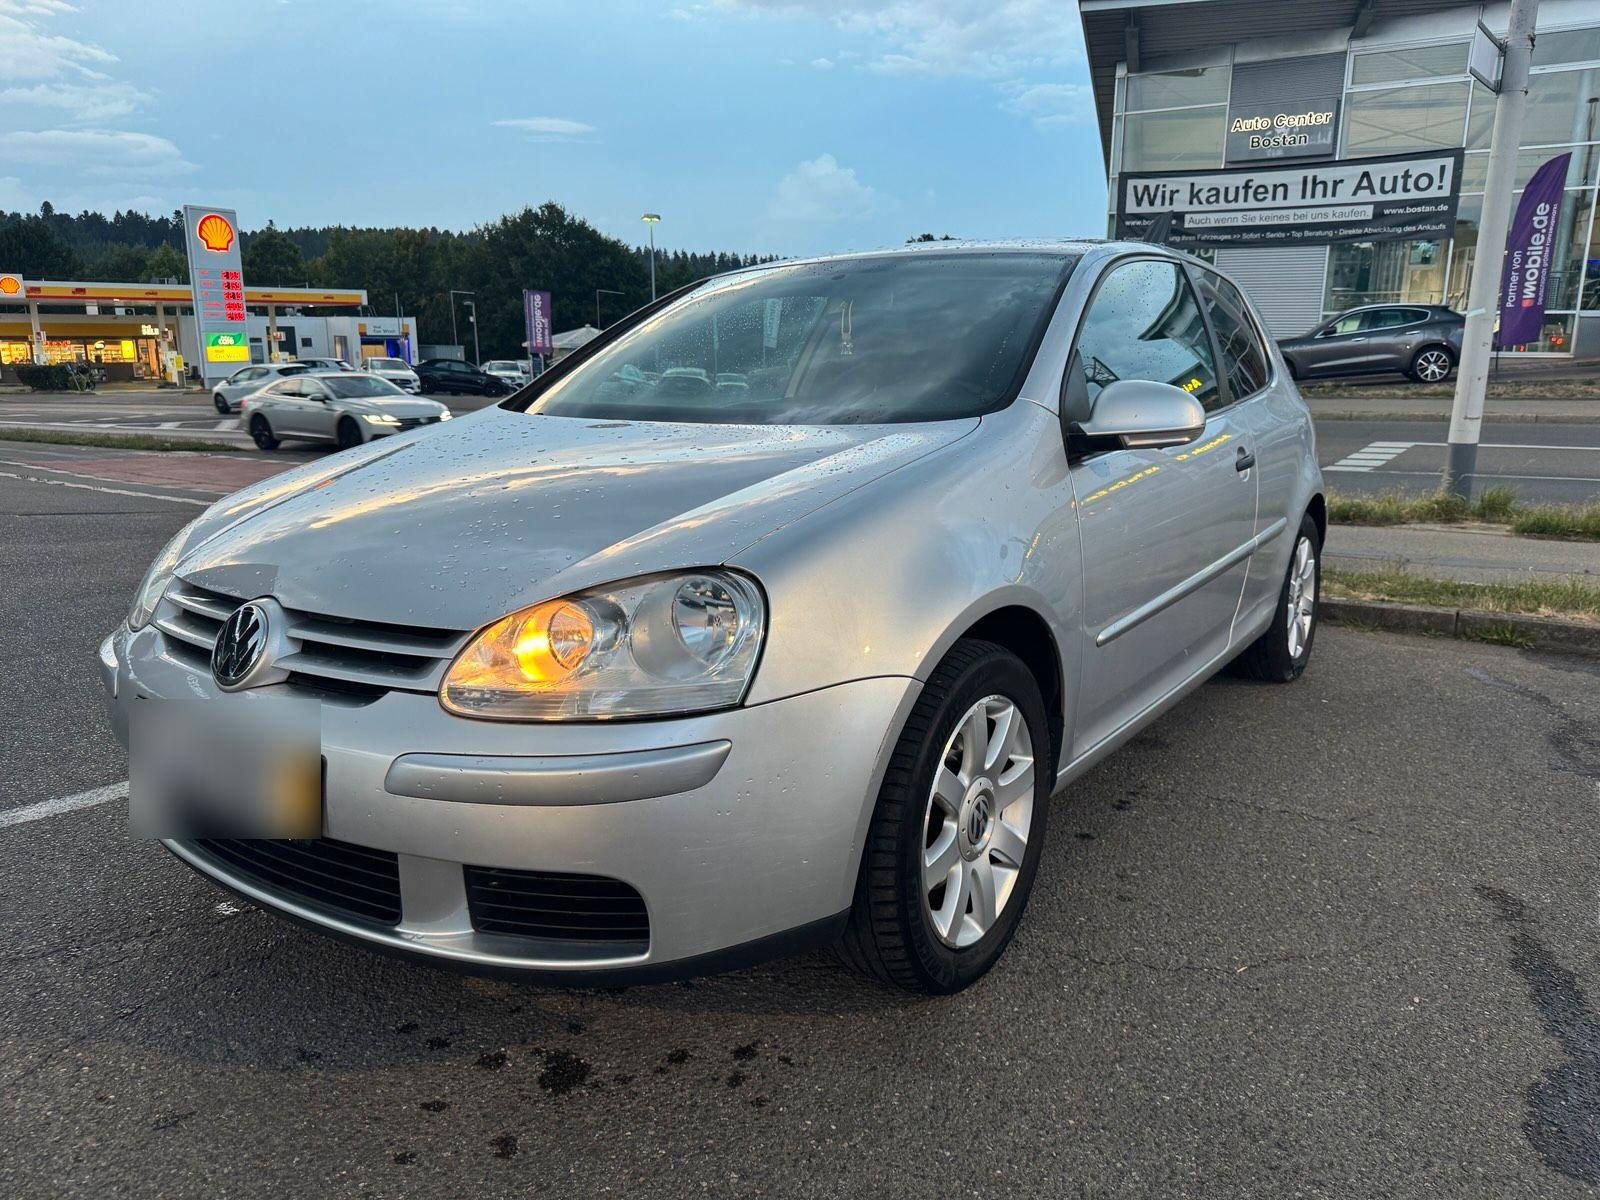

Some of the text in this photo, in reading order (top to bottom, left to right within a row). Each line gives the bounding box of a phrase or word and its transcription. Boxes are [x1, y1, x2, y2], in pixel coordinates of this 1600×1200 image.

[1231, 117, 1270, 132] Auto
[1274, 112, 1332, 128] Center
[1250, 133, 1309, 149] Bostan
[1132, 165, 1447, 207] Wir kaufen Ihr Auto!
[1188, 208, 1369, 225] Auch wenn Sie keines bei uns kaufen.
[1383, 203, 1449, 215] www.bostan.de
[1242, 232, 1261, 240] Sofort
[1291, 230, 1302, 238] Top
[1303, 230, 1333, 238] Beratung
[1417, 223, 1447, 232] Ankaufs
[1522, 202, 1550, 299] mobile.de
[1506, 251, 1522, 307] Partner von
